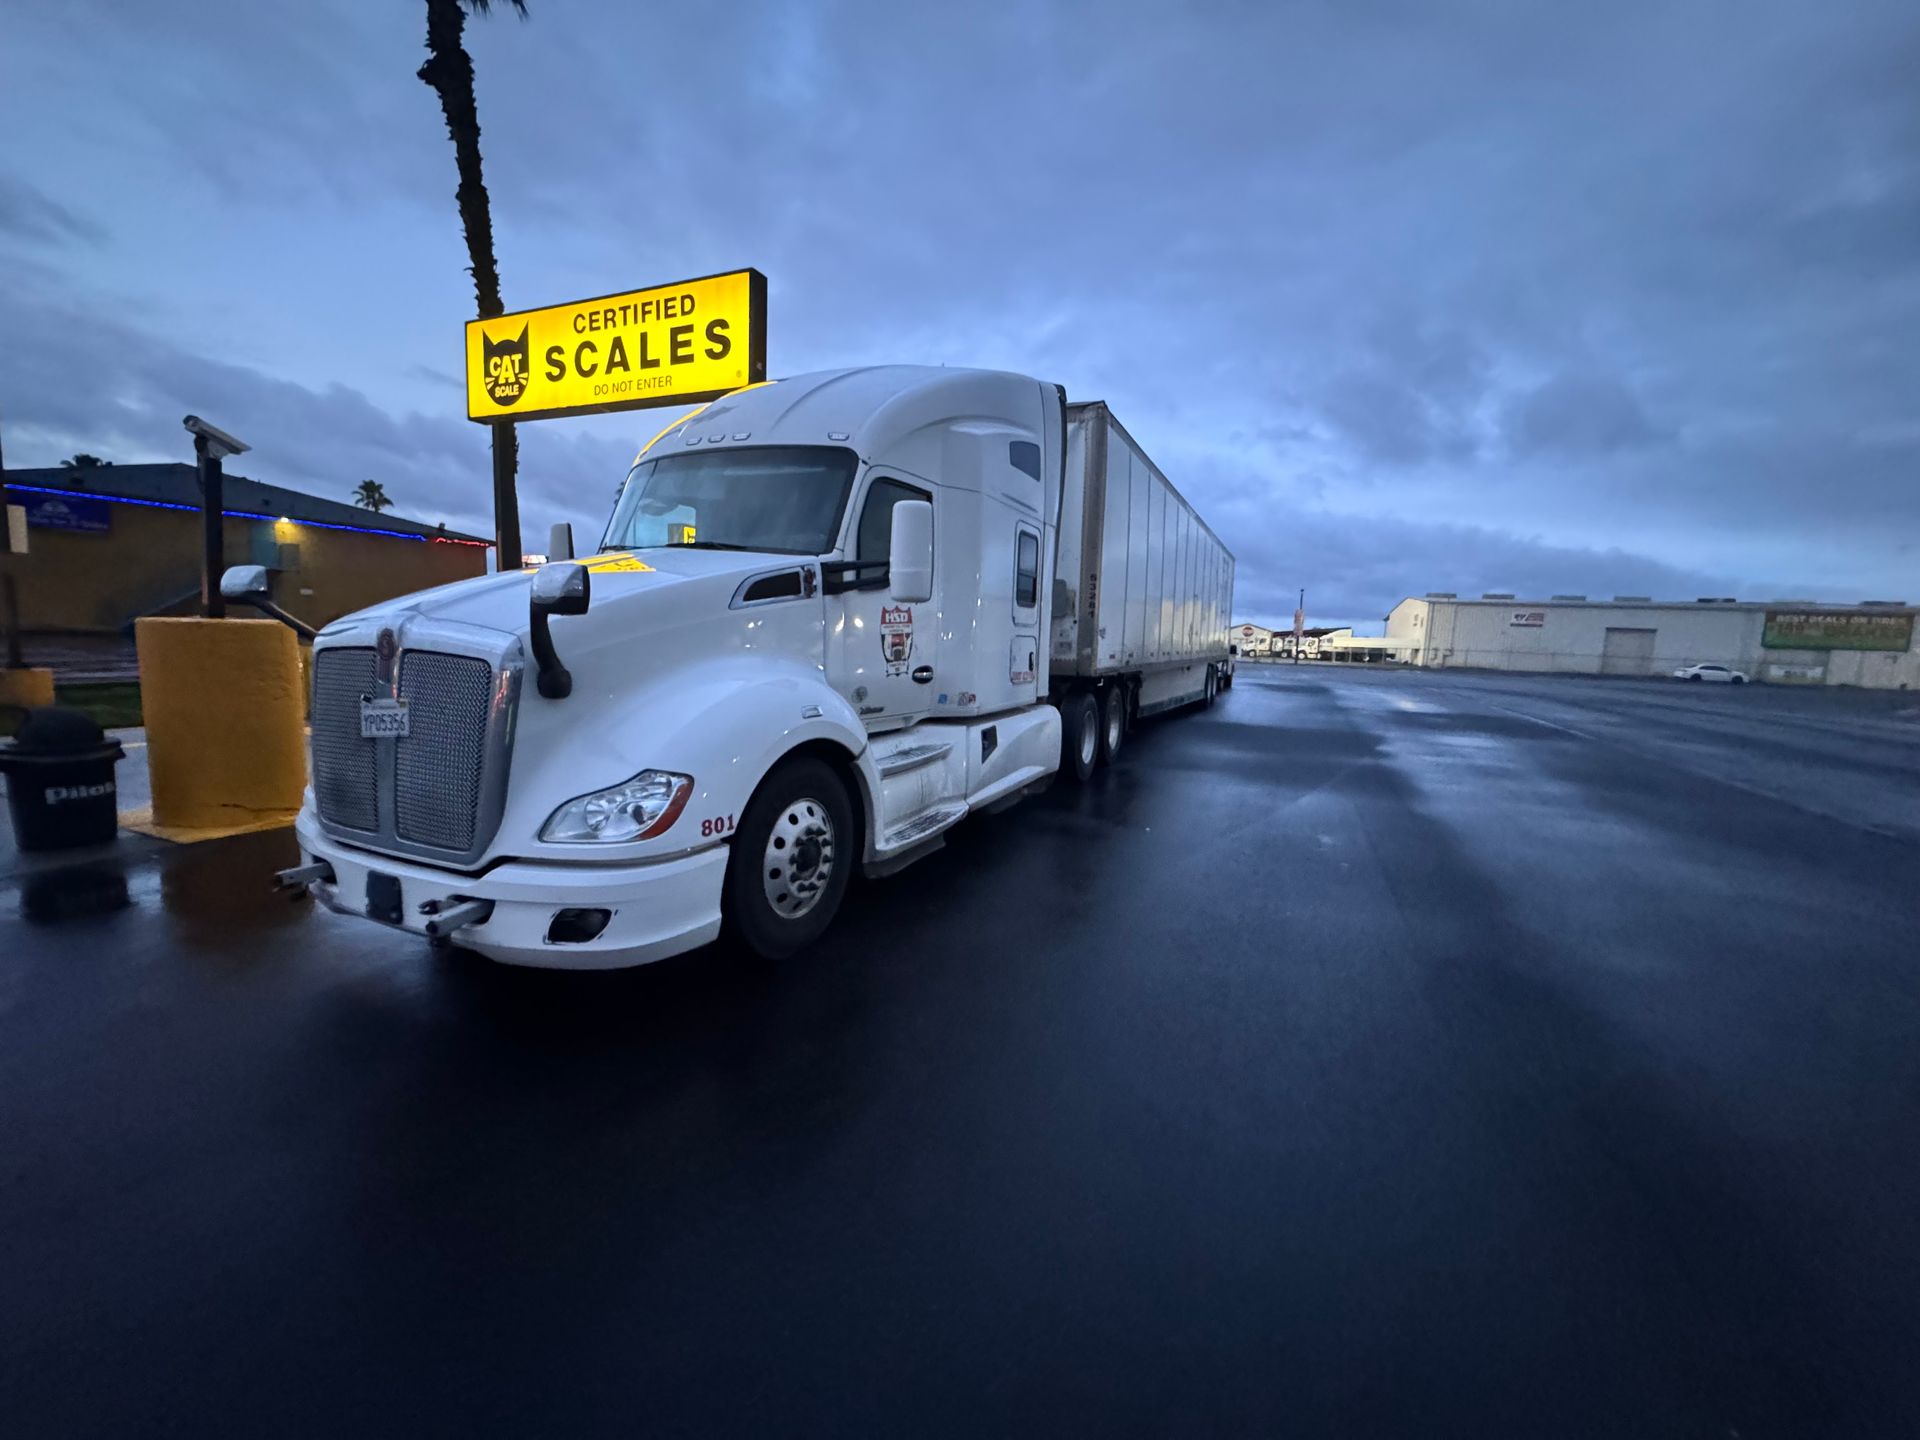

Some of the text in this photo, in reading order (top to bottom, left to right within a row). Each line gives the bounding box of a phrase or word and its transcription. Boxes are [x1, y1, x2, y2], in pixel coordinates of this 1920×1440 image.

[573, 294, 695, 334] CERTIFIED
[545, 318, 732, 382] SCALES
[489, 353, 523, 385] CAT
[494, 384, 520, 398] SCALE
[594, 375, 673, 396] DO NOT ENTER
[885, 612, 909, 624] HSD
[701, 813, 734, 838] 801
